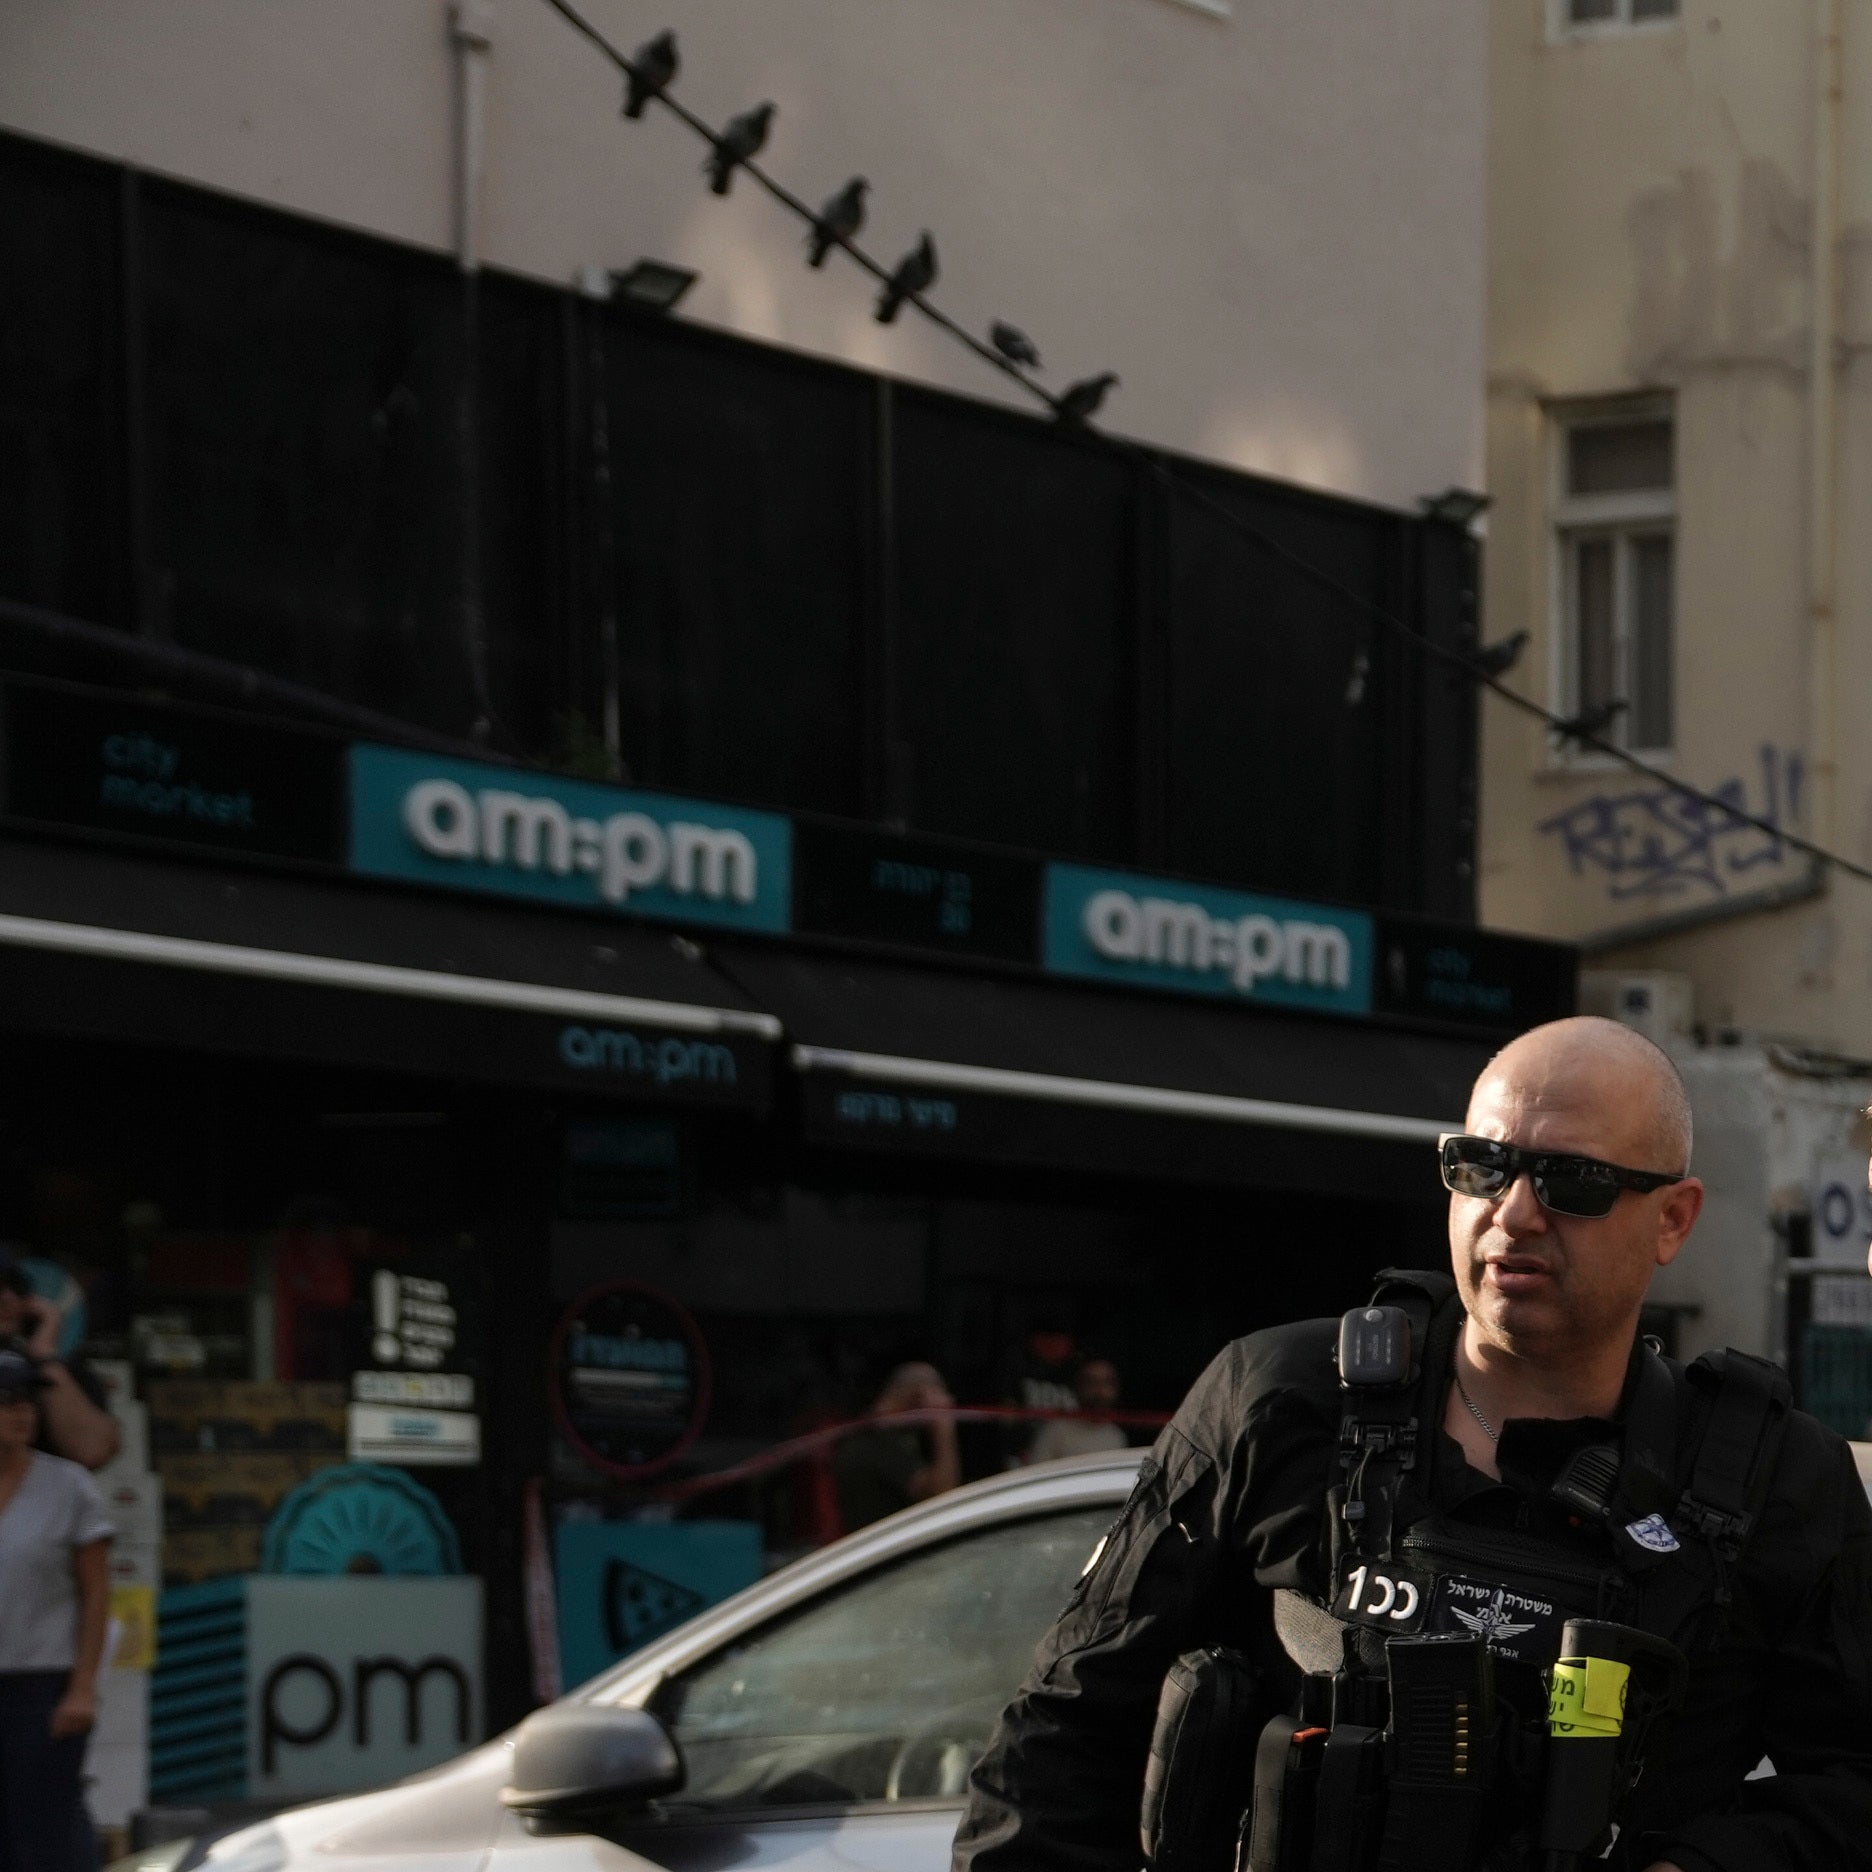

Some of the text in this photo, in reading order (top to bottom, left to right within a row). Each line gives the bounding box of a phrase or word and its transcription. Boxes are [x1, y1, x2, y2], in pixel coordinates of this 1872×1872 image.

[404, 777, 757, 903] am:pm
[1084, 888, 1350, 992] am:pm
[559, 1024, 737, 1086] am:pm
[1447, 1579, 1553, 1616] משטרת ישראל
[261, 1652, 472, 1778] pm
